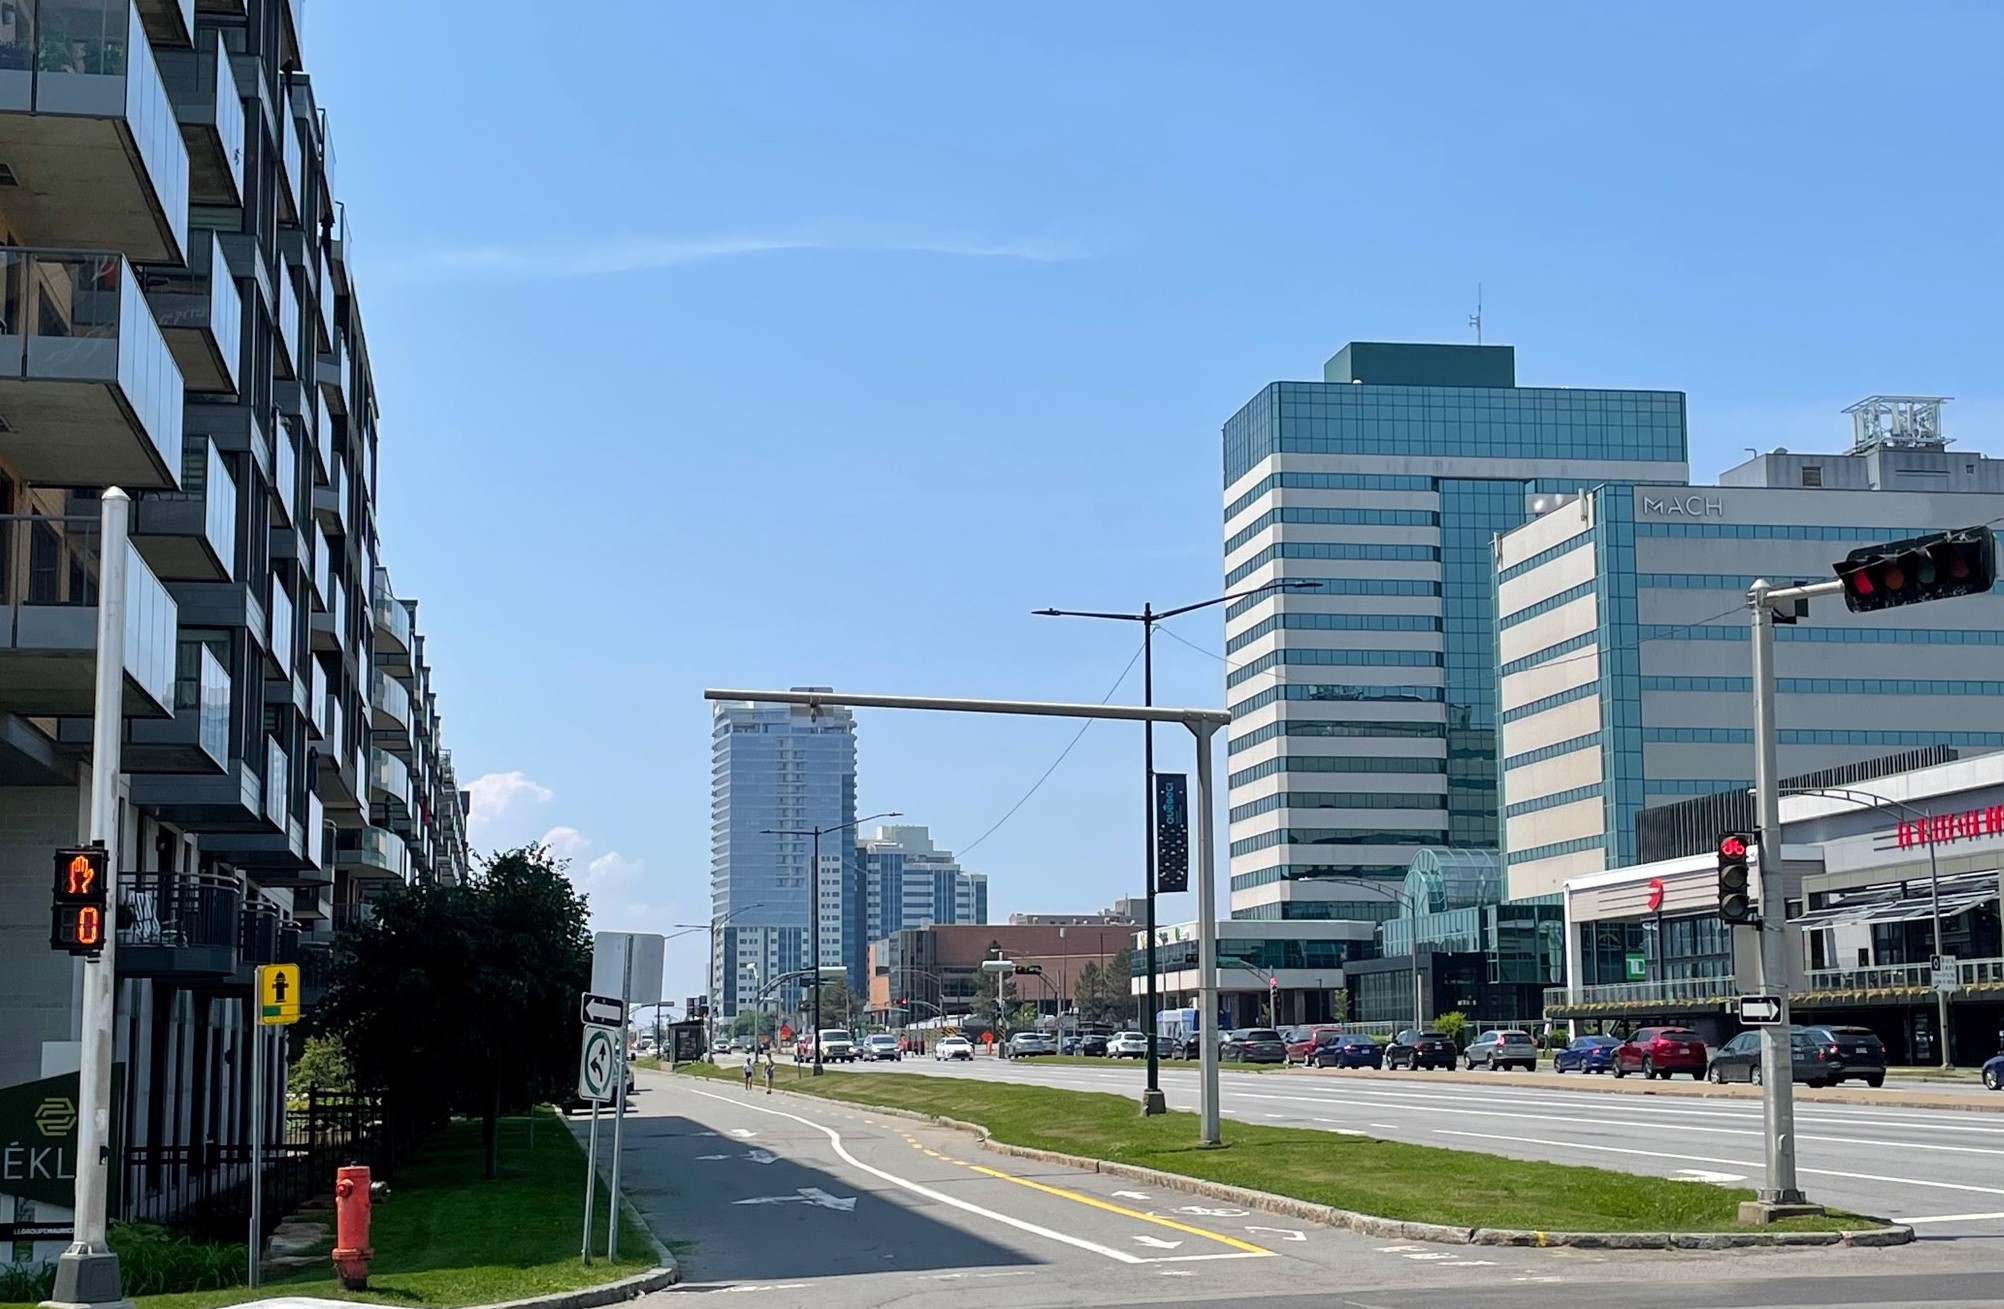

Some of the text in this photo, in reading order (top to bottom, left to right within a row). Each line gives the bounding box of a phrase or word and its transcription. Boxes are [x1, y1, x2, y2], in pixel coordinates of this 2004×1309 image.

[1643, 495, 1723, 516] MACH
[79, 906, 98, 944] 0
[1625, 958, 1646, 975] TD
[3, 1141, 76, 1180] ÉKL
